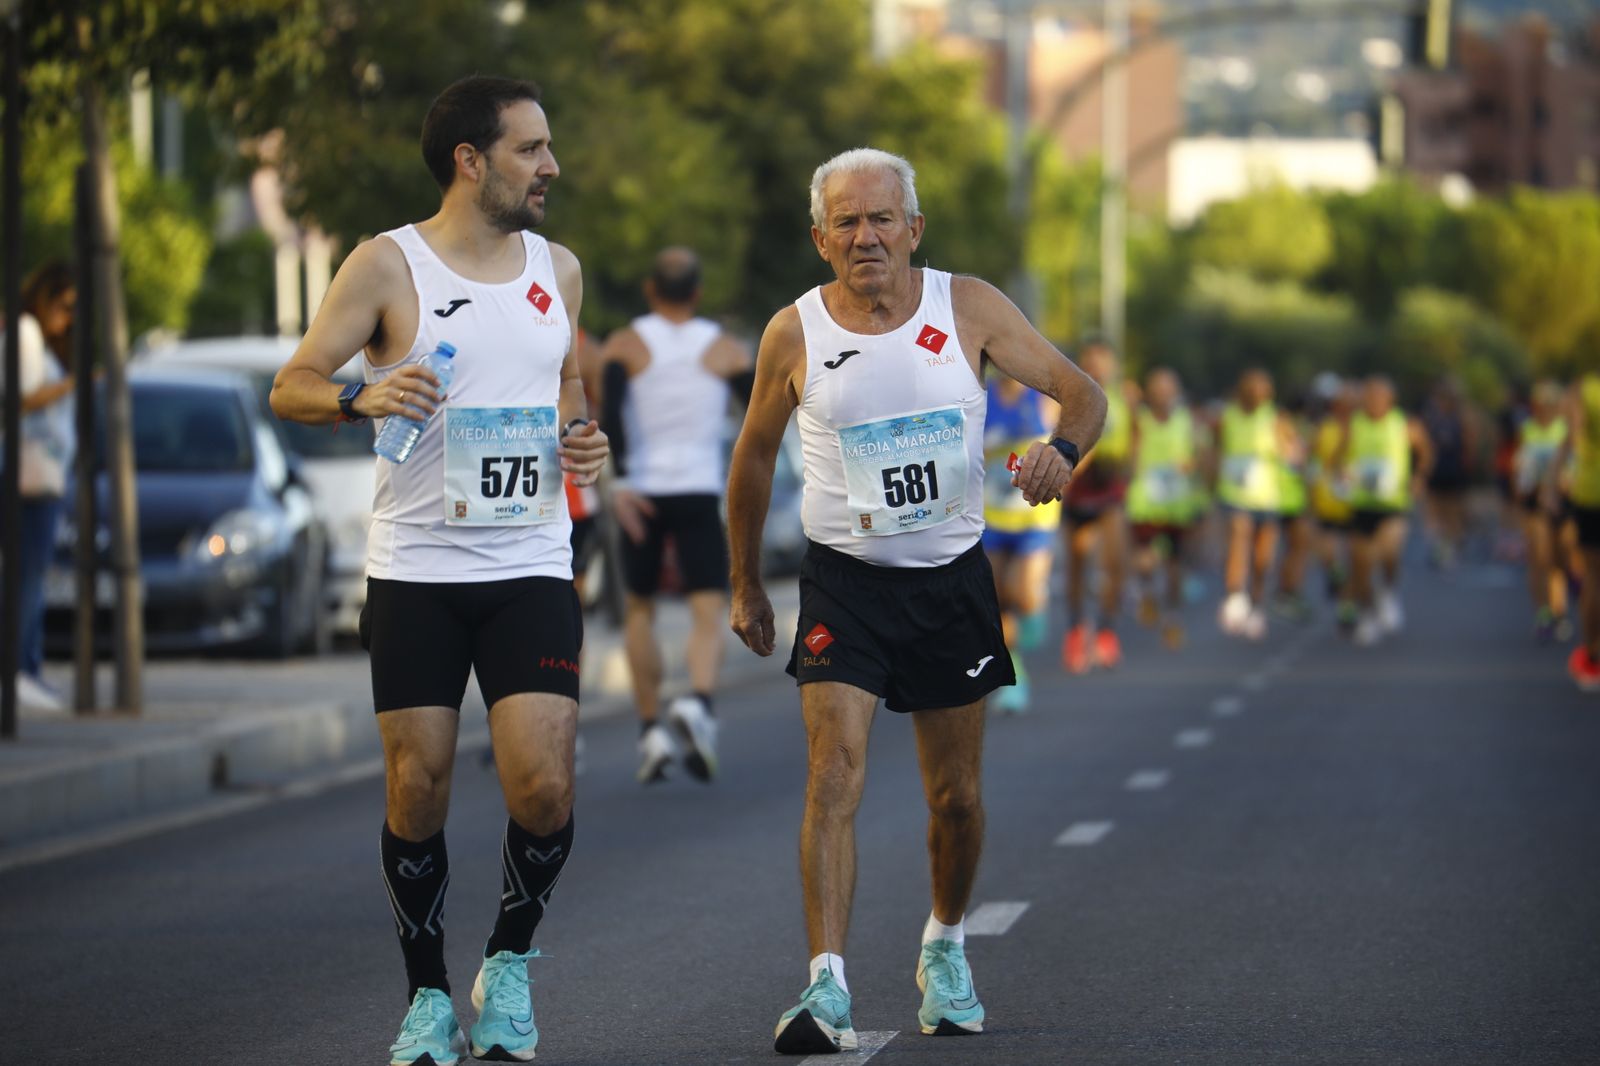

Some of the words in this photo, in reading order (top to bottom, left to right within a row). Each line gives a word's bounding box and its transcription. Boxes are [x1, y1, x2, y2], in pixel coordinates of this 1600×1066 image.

[532, 317, 559, 327] TALAI
[924, 354, 956, 368] TALAI
[451, 427, 498, 441] MEDIA
[504, 423, 556, 441] MARATÓN
[845, 441, 891, 459] MEDIA
[896, 426, 961, 449] MARATÓN
[481, 456, 538, 498] 575
[882, 461, 939, 508] 581
[898, 509, 932, 522] serizona
[803, 657, 830, 668] TALAI
